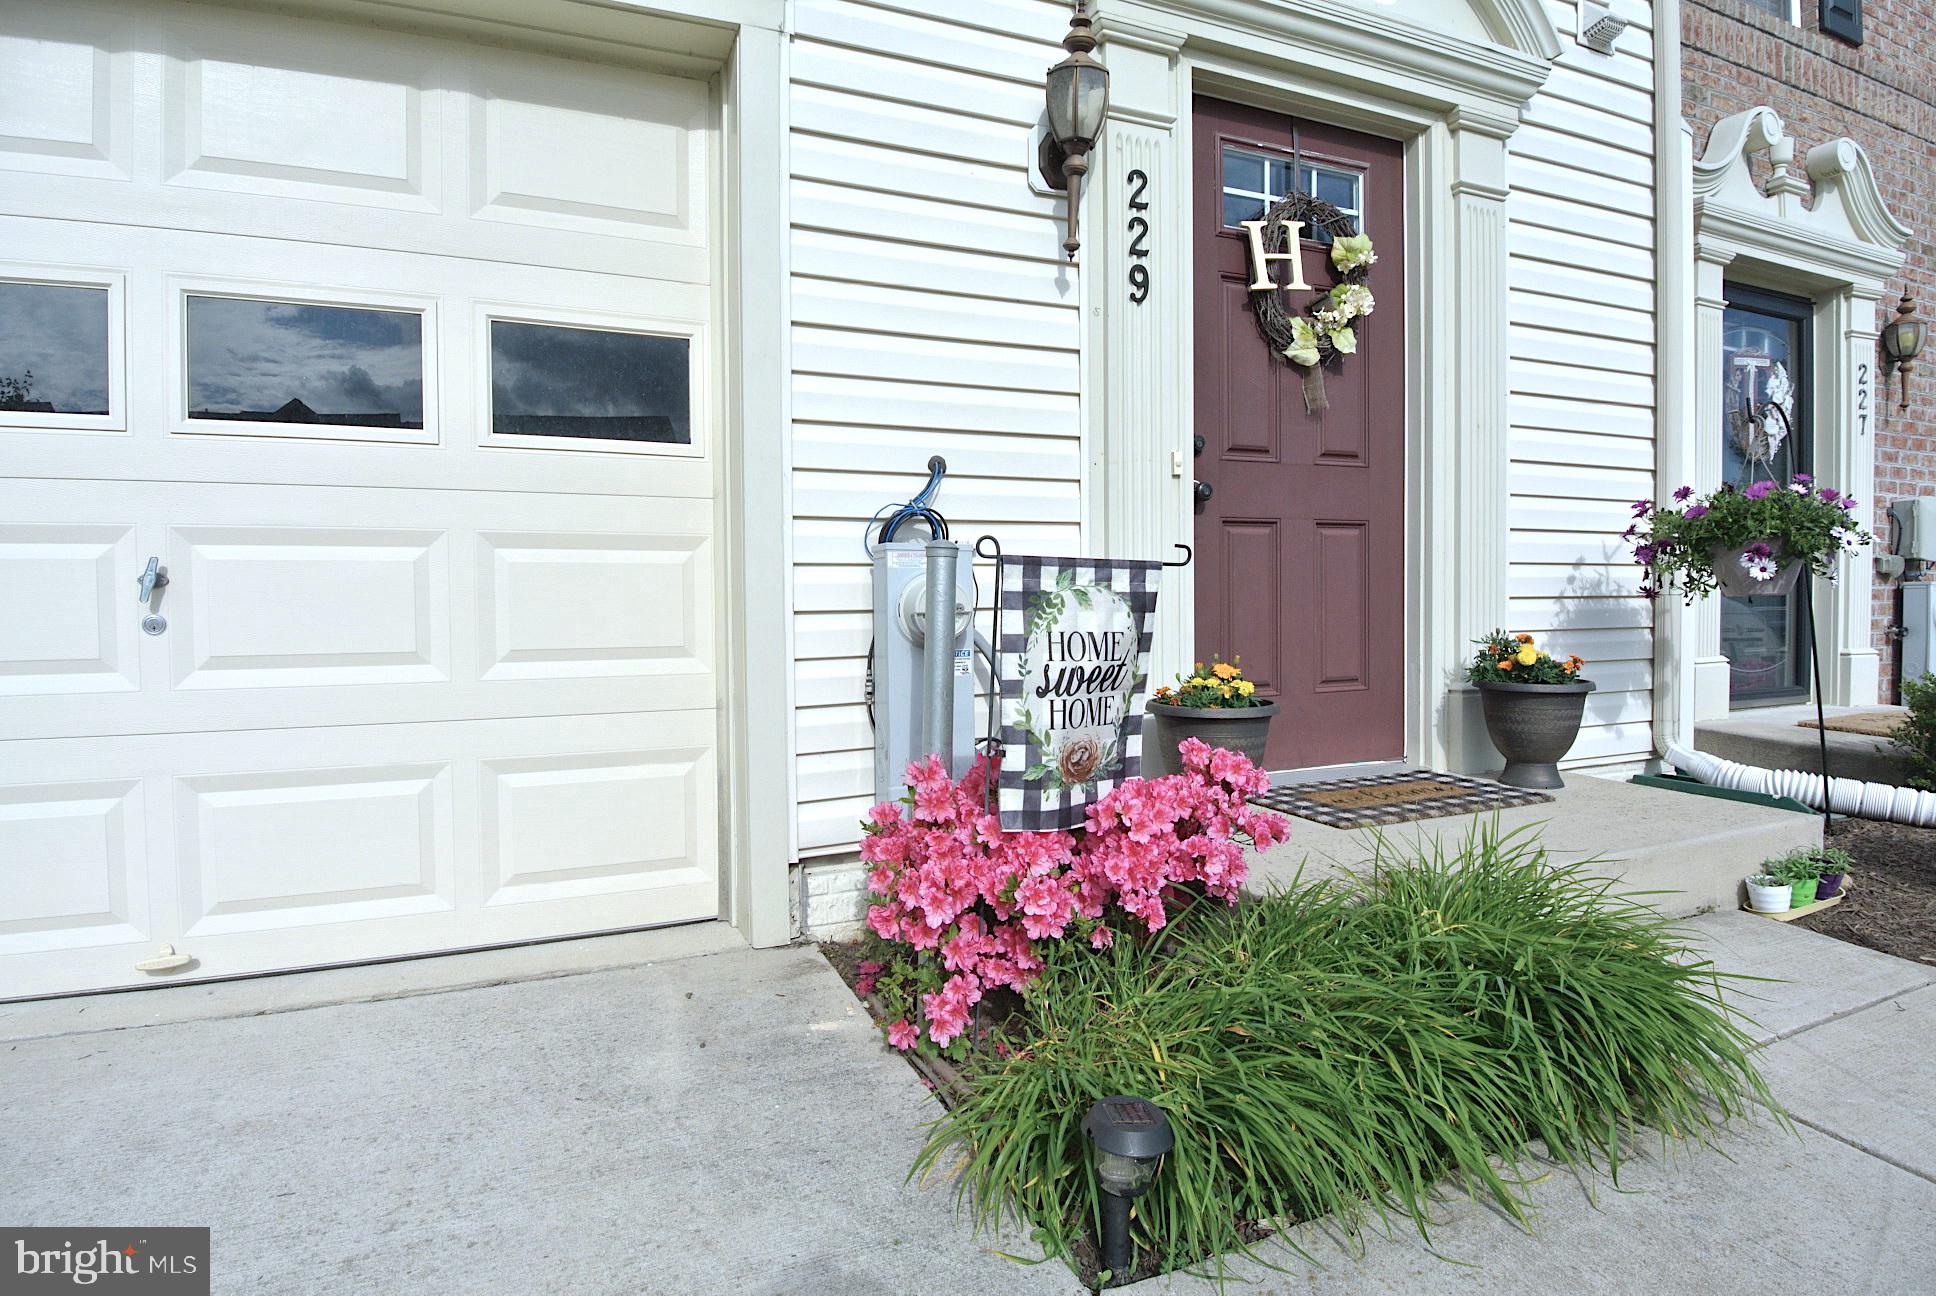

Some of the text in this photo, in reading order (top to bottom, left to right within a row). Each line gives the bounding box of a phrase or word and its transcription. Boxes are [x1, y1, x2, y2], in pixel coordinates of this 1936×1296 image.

[1127, 169, 1149, 304] 229
[1240, 220, 1312, 291] H
[1857, 363, 1868, 436] 227
[1036, 648, 1130, 698] sweet
[1047, 631, 1124, 662] HOME
[1048, 695, 1115, 730] HOME
